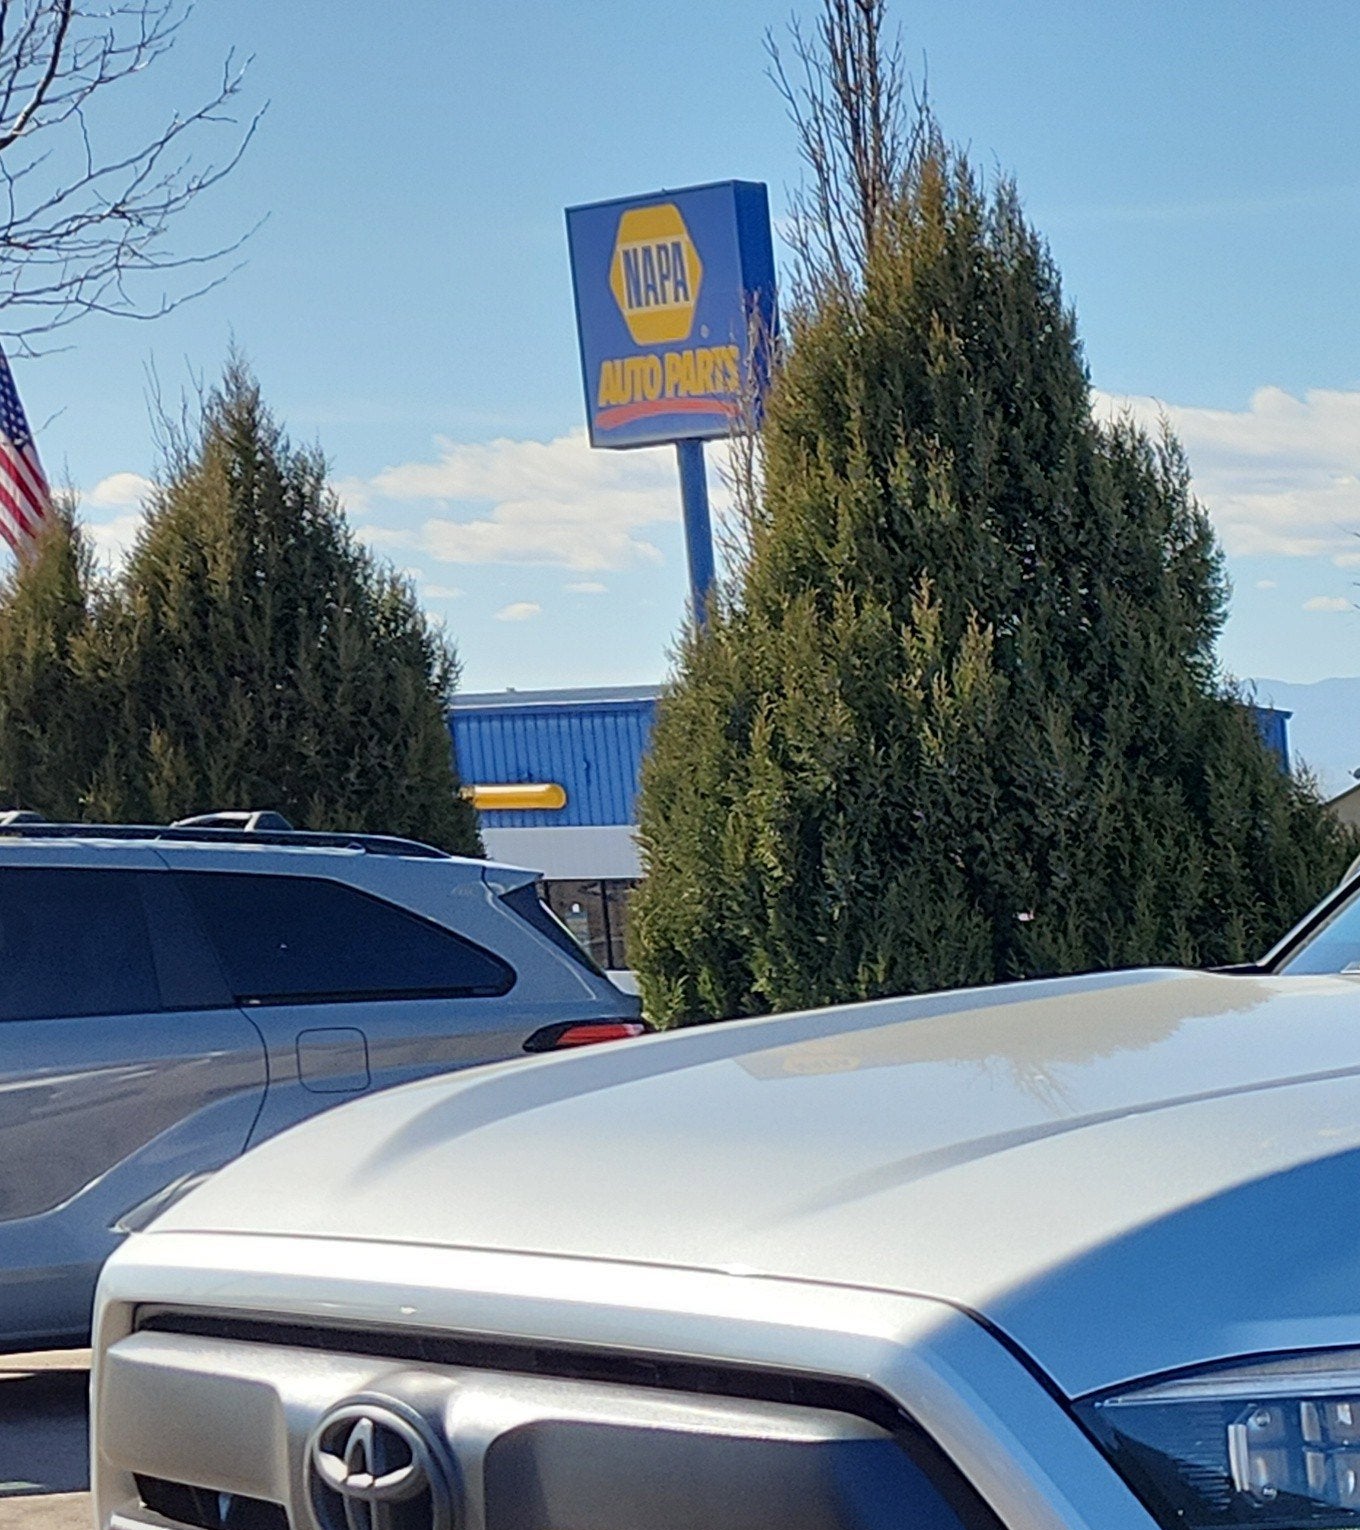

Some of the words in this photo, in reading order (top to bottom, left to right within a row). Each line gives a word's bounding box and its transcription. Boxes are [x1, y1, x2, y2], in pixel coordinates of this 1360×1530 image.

[622, 241, 689, 308] NAPA
[599, 355, 662, 406] AUTO
[665, 346, 741, 397] PARTS
